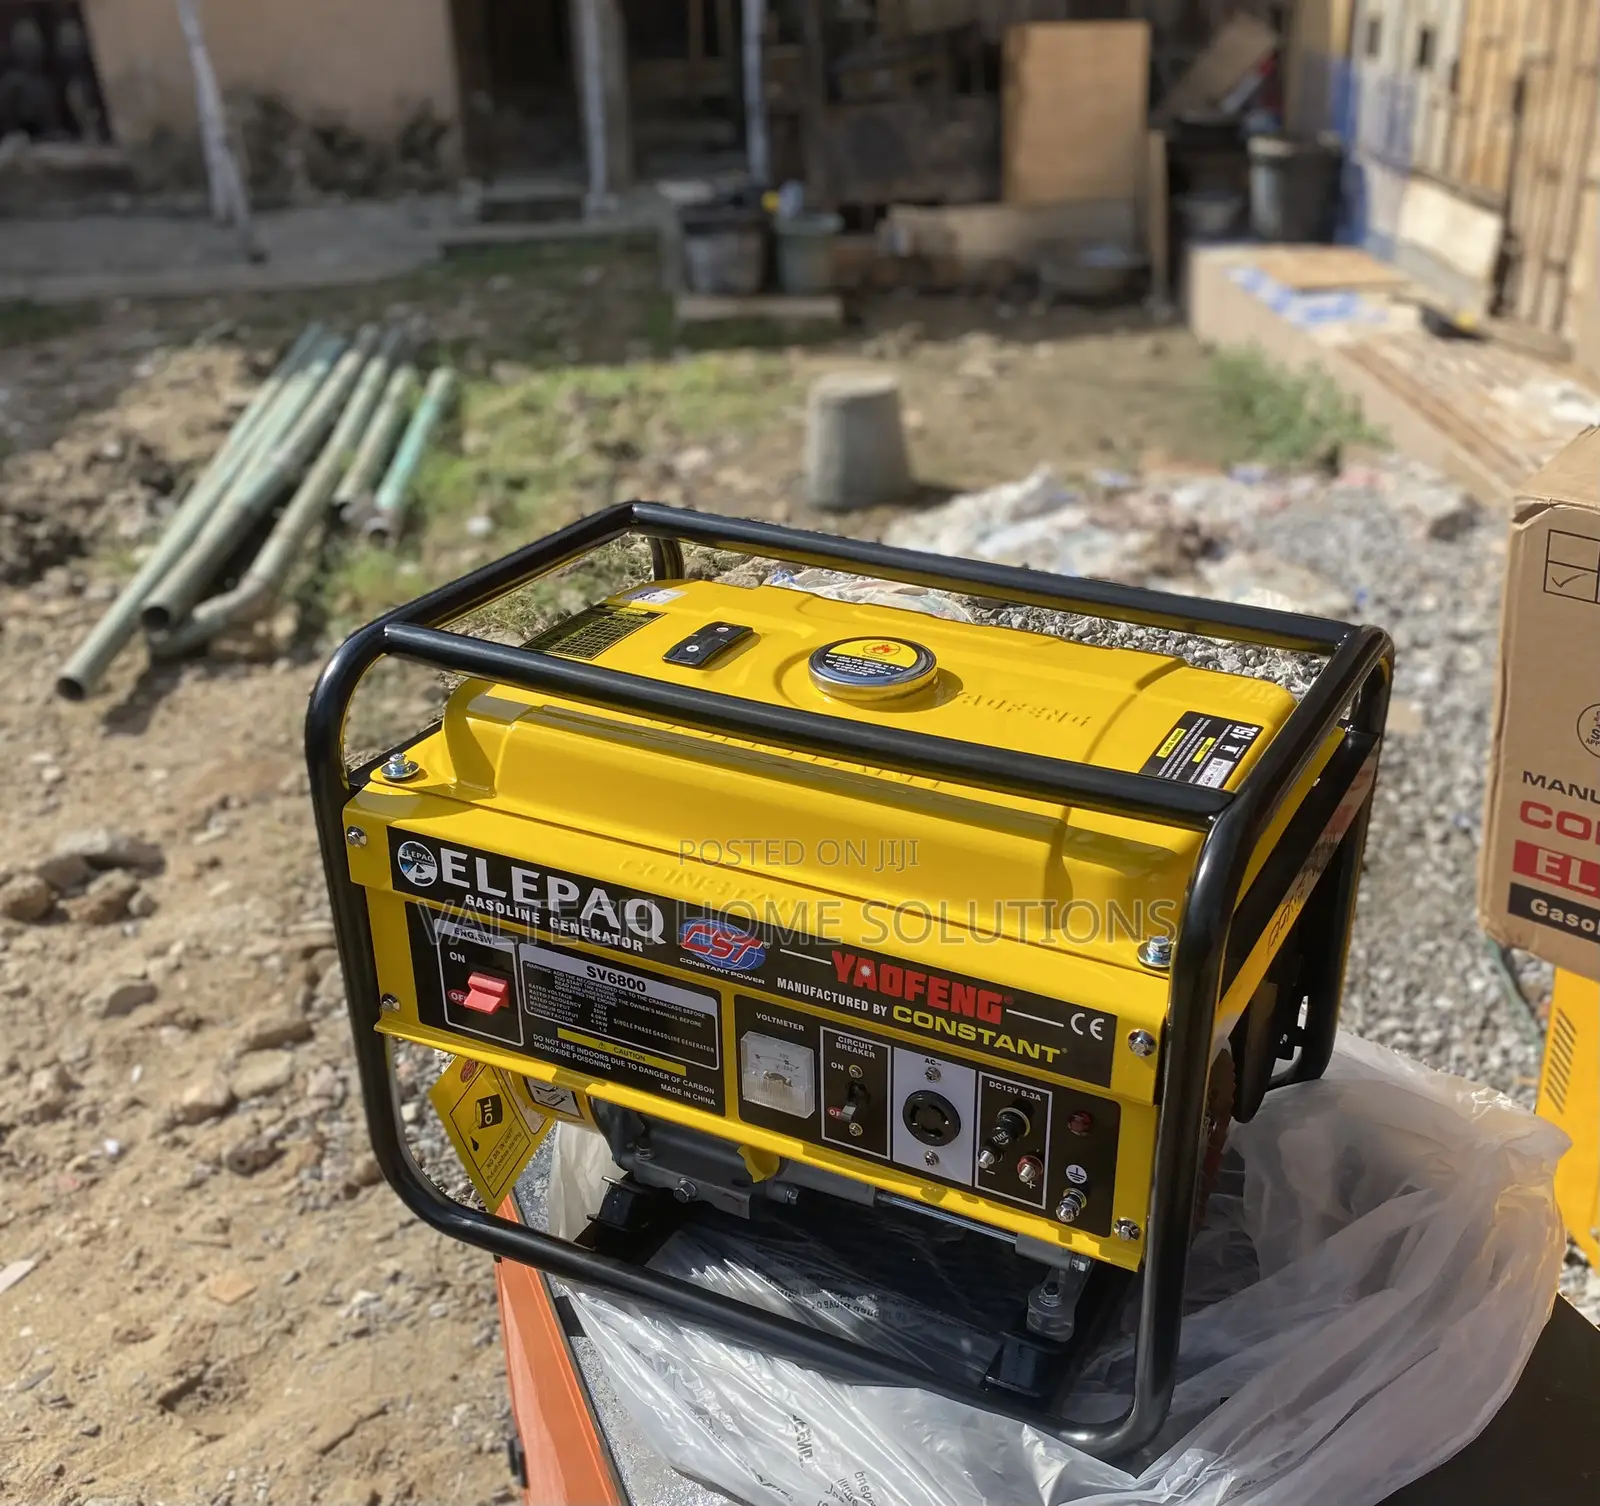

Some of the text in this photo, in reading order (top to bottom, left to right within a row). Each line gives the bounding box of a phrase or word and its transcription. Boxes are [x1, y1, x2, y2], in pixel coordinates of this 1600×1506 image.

[1230, 726, 1259, 740] 15L
[1520, 800, 1600, 846] CO
[1535, 848, 1596, 892] EL
[440, 847, 666, 944] ELEPAQ
[465, 894, 644, 952] GASOLINE GENERATOR
[681, 924, 764, 963] CST
[450, 952, 466, 963] ON
[586, 966, 646, 993] SV6800
[680, 957, 765, 984] CONSTANT POWER
[528, 983, 546, 992] RATED
[528, 989, 547, 998] RATED
[832, 950, 1002, 1024] YAOFENG
[529, 995, 547, 1004] RATED
[648, 998, 682, 1012] CRANKCASE
[683, 1007, 706, 1019] BEFORE
[656, 1010, 678, 1020] MANUAL
[680, 1016, 702, 1028] BEFORE
[756, 1012, 804, 1032] VOLTMETER
[777, 977, 1060, 1064] MANUFACTURED BY CONSTANT
[1070, 1012, 1104, 1040] CE
[614, 1018, 714, 1054] SINGLE PHASE GASOLINE GENERATOR
[838, 1036, 873, 1051] CIRCUIT
[534, 1042, 612, 1070] MONOXIDE POISONING
[614, 1046, 646, 1062] CAUTION
[836, 1042, 876, 1059] BREAKER
[533, 1034, 544, 1042] DO
[545, 1037, 559, 1047] NOT
[561, 1042, 576, 1052] USE
[577, 1046, 609, 1062] INDOORS
[611, 1058, 626, 1067] DUE
[627, 1062, 637, 1070] TO
[638, 1066, 670, 1081] DANGER
[682, 1080, 714, 1095] CARBON
[830, 1062, 844, 1071] ON
[660, 1083, 682, 1096] MADE
[692, 1094, 716, 1106] CHINA
[988, 1081, 1042, 1101] DC12V 8.3A
[484, 1098, 492, 1124] OIL
[829, 1108, 842, 1116] OF
[992, 1131, 1008, 1142] FUSE
